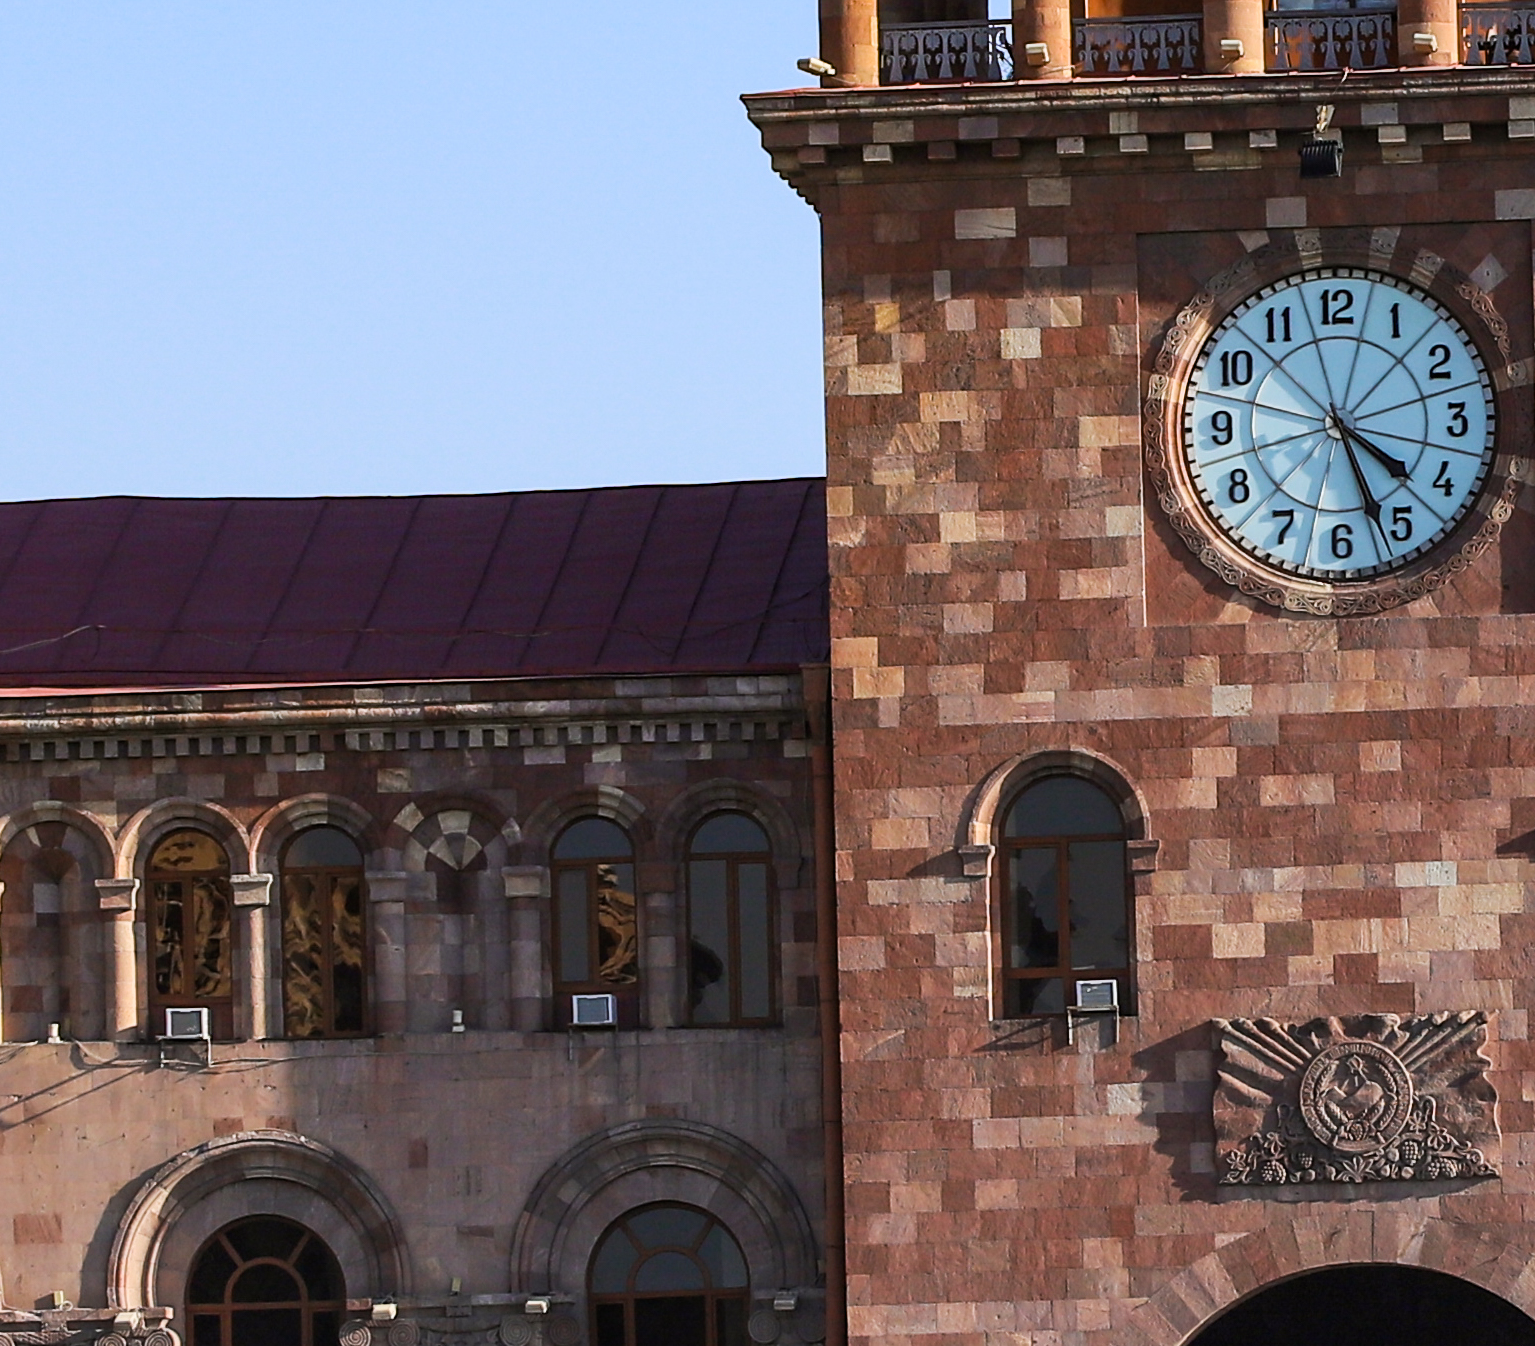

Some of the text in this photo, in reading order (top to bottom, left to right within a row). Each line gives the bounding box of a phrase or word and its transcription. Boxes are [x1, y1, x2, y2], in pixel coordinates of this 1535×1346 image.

[1265, 306, 1292, 343] 11
[1320, 289, 1354, 325] 12
[1390, 302, 1401, 338] 1
[1219, 350, 1253, 386] 10
[1428, 344, 1451, 380] 2
[1211, 410, 1233, 445] 9
[1446, 401, 1469, 437] 3
[1228, 468, 1250, 504] 8
[1432, 461, 1455, 496] 4
[1272, 509, 1295, 545] 7
[1331, 524, 1353, 558] 6
[1390, 506, 1413, 542] 5
